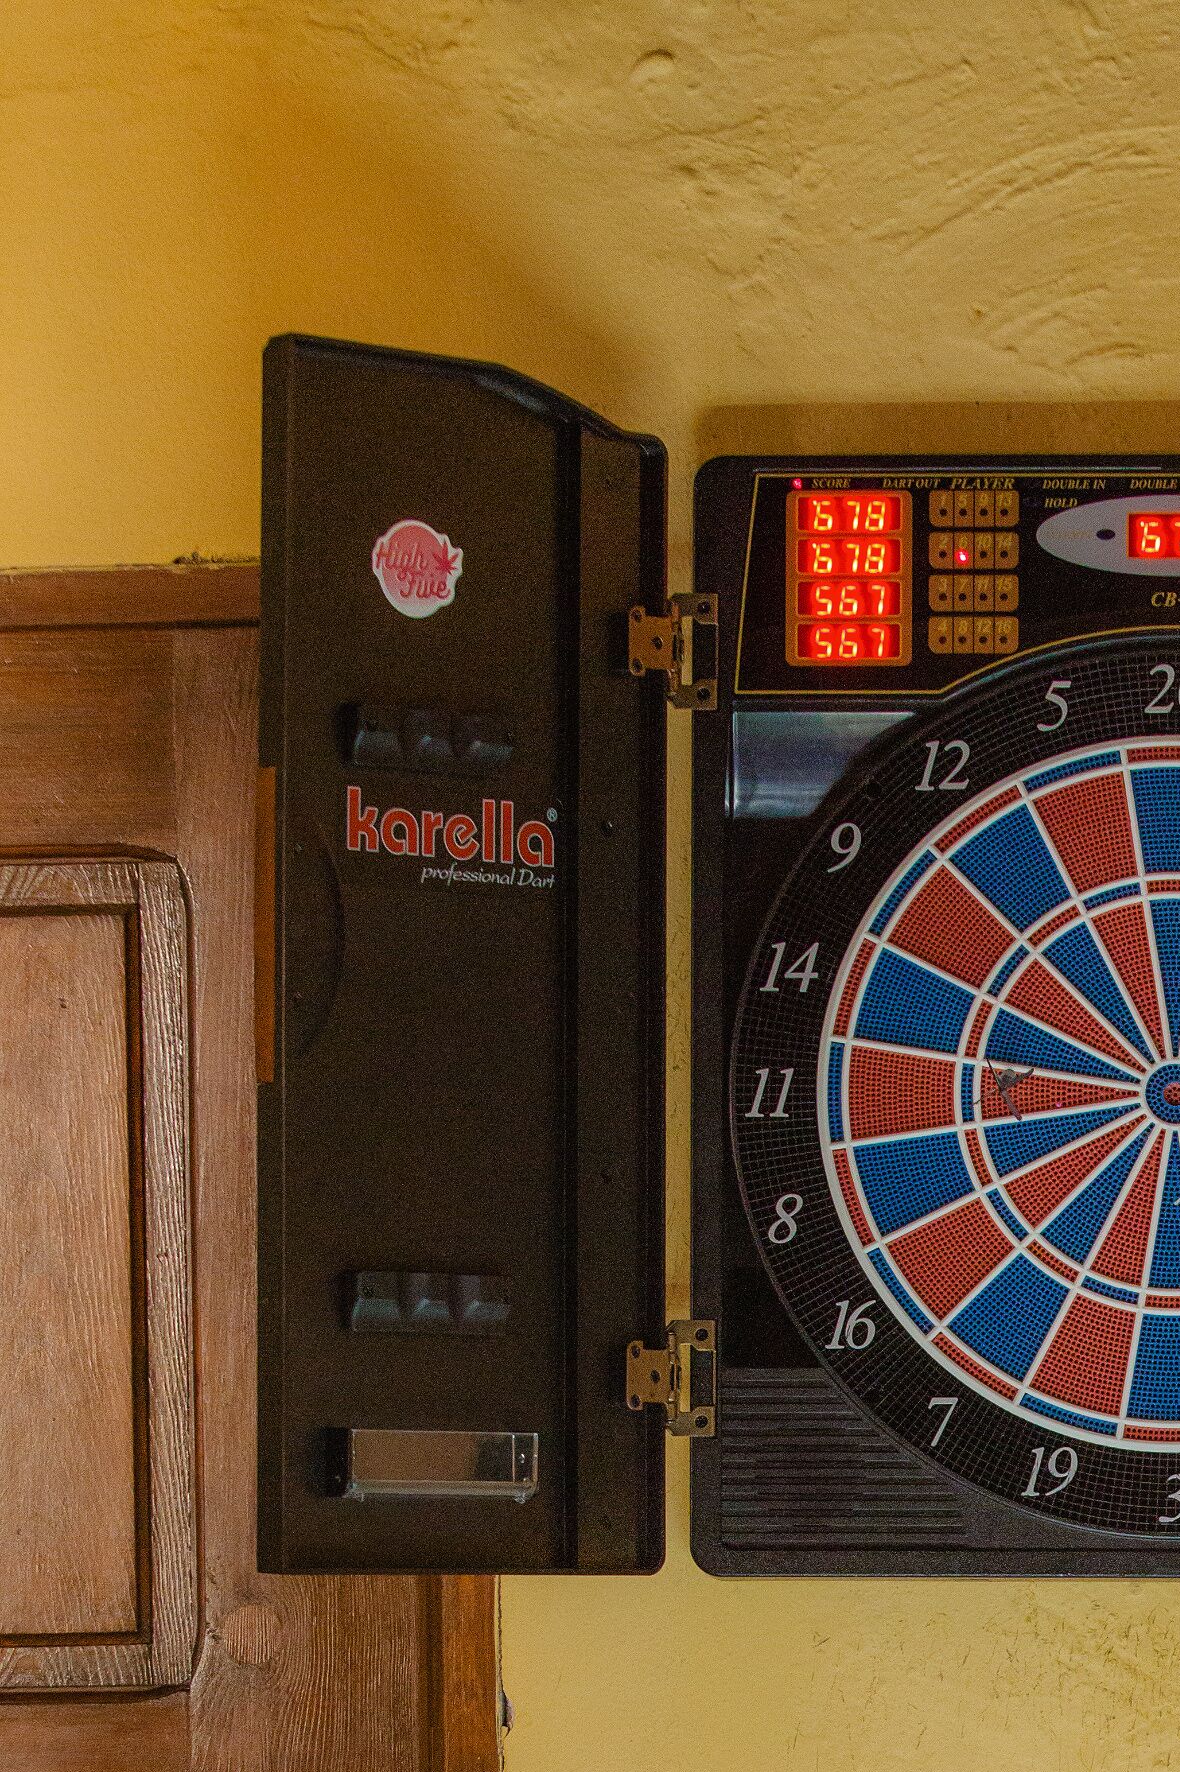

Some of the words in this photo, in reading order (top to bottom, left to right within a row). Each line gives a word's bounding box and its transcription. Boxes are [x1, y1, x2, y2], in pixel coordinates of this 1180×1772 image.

[812, 478, 850, 488] SCORE
[883, 478, 911, 488] DART
[916, 478, 941, 488] OUT
[951, 478, 1015, 489] PLAYER
[1042, 479, 1089, 490] DOUBLE
[1093, 479, 1106, 490] IN
[1130, 479, 1177, 490] DOUBLE
[1045, 498, 1078, 508] HOLD
[376, 542, 428, 581] High
[816, 585, 885, 615] 567
[816, 628, 884, 657] 567
[1037, 680, 1071, 731] 5
[915, 740, 970, 791] 12
[827, 823, 862, 873] 9
[420, 861, 515, 886] professional
[517, 868, 555, 888] Dart
[759, 942, 818, 993] 14
[745, 1068, 793, 1118] 11
[768, 1193, 803, 1243] 8
[825, 1300, 876, 1350] 16
[927, 1397, 958, 1447] 7
[1021, 1446, 1078, 1497] 19
